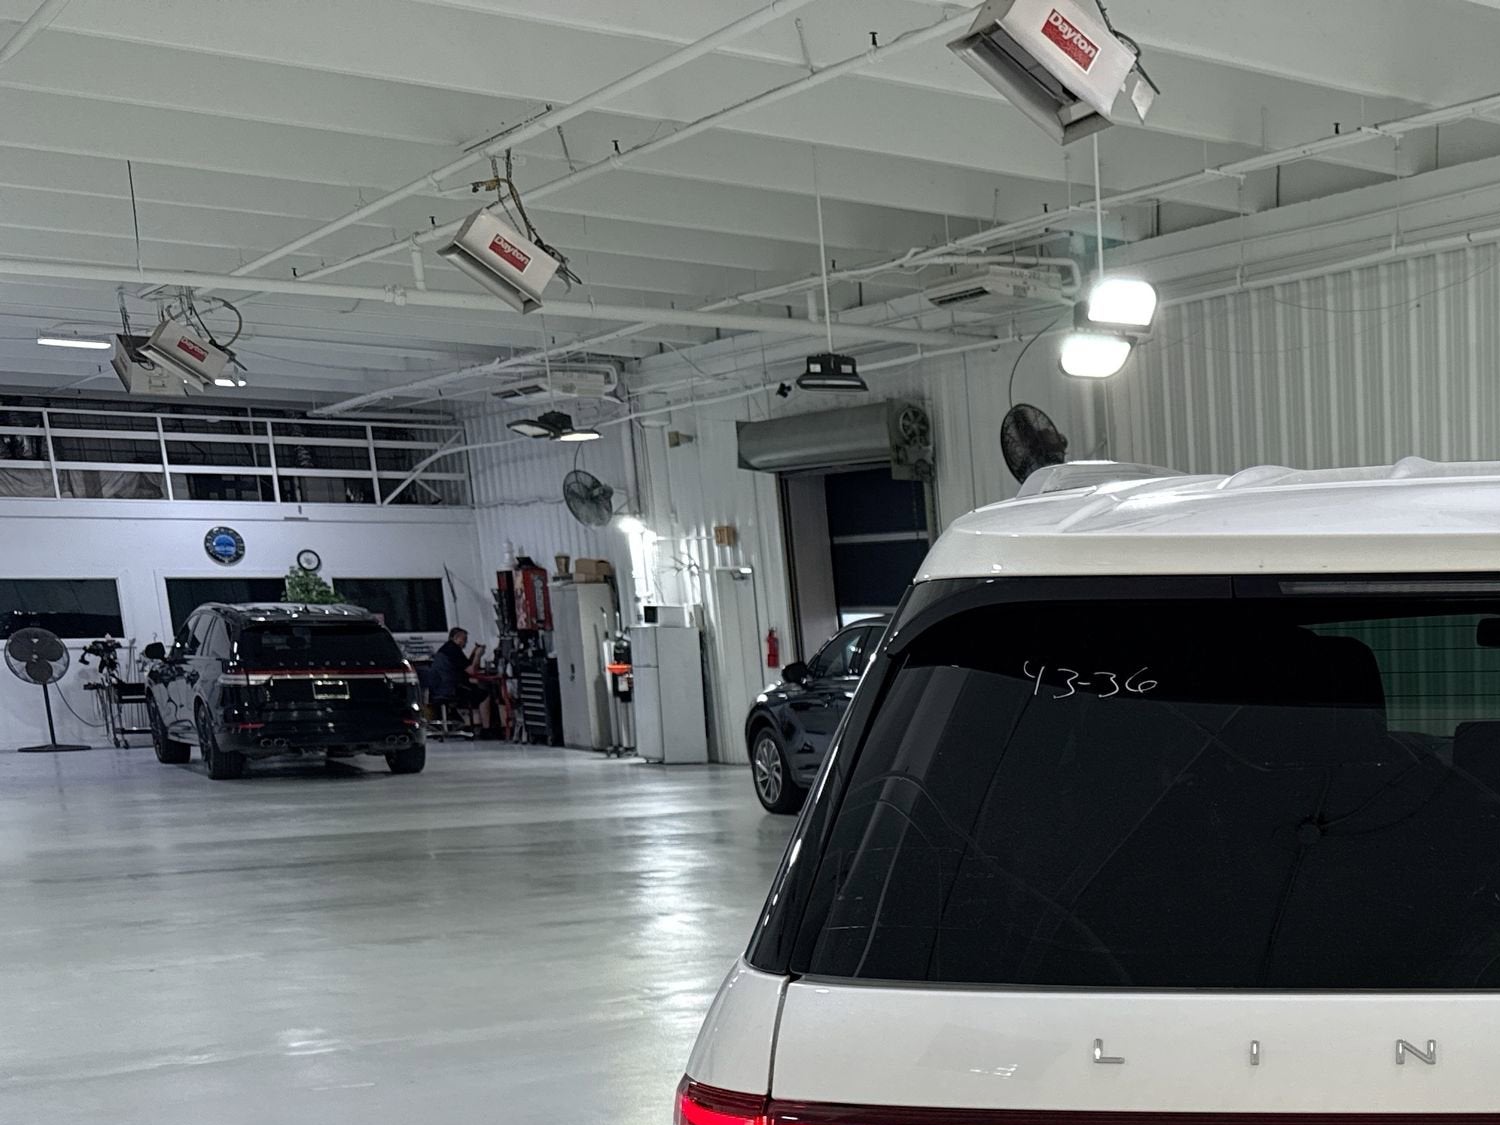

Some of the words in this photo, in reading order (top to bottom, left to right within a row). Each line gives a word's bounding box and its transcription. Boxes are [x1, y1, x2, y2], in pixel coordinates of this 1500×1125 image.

[1048, 12, 1096, 58] Dayton
[494, 236, 529, 264] Dayton
[1023, 660, 1158, 699] 43-36
